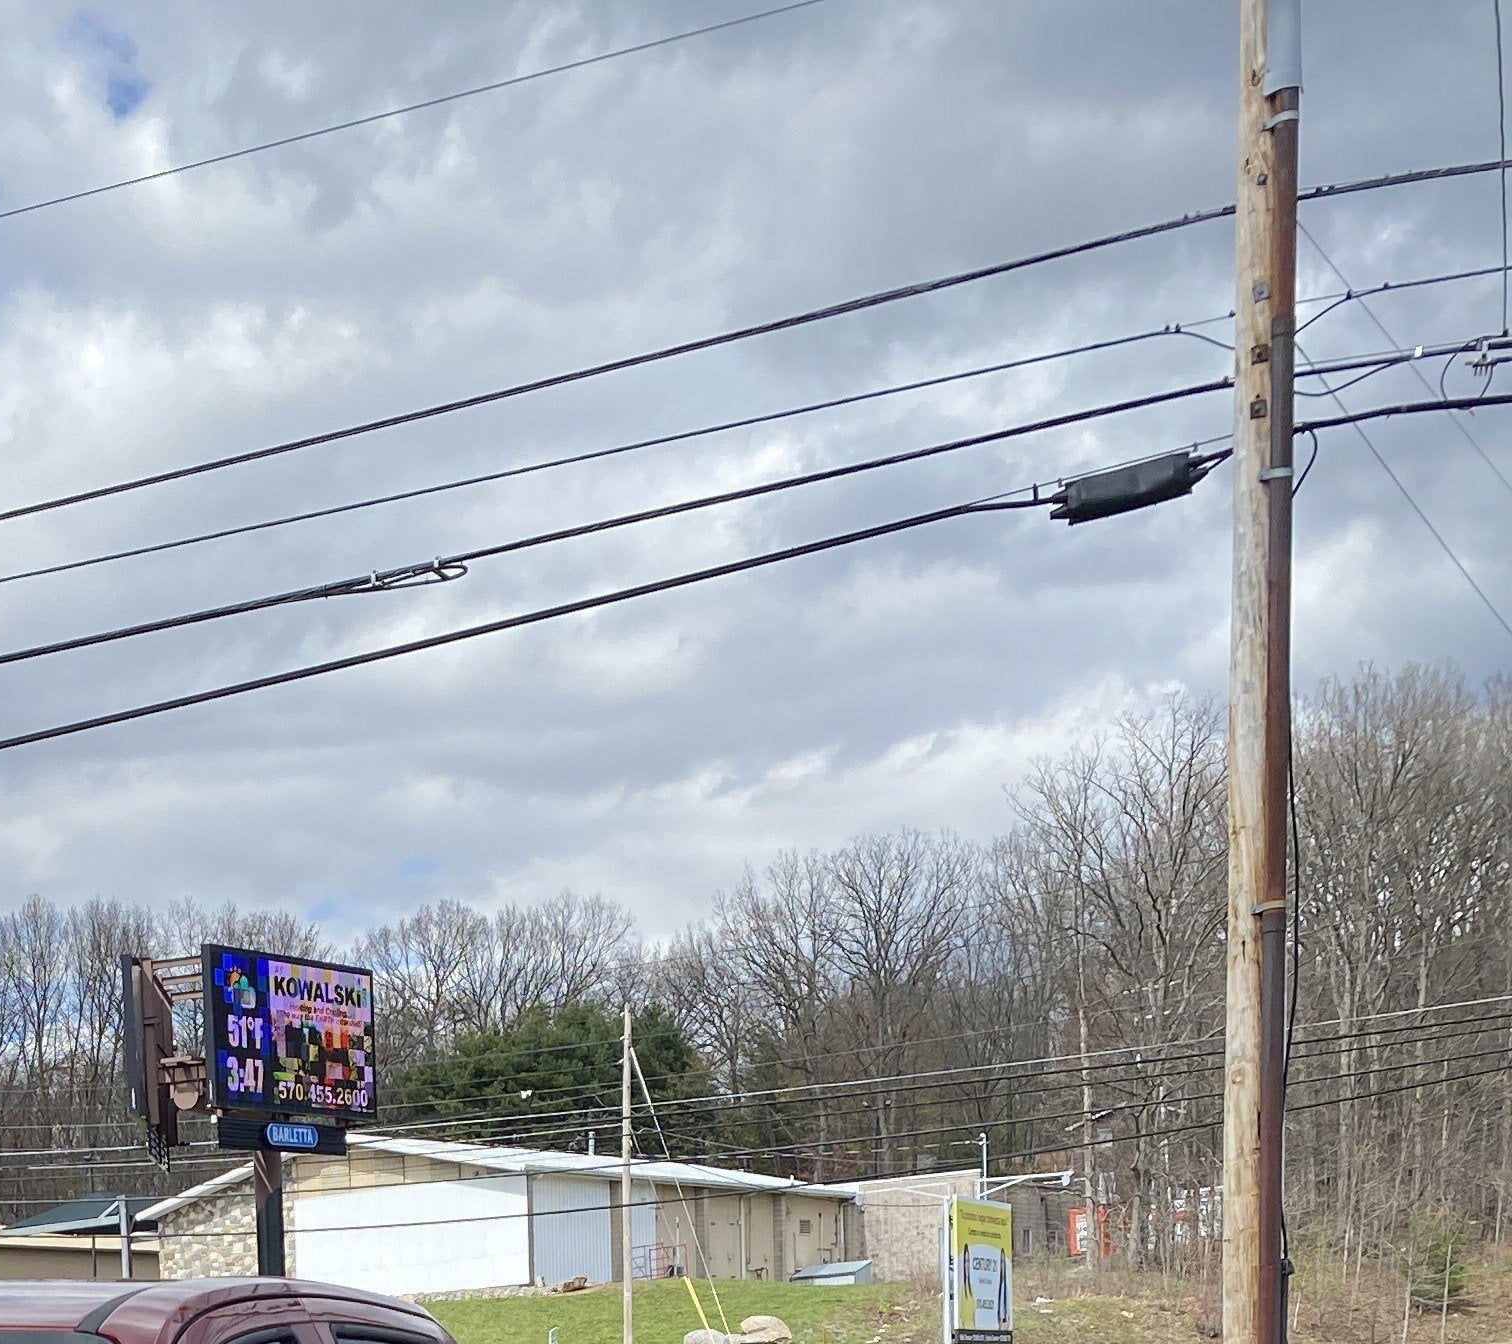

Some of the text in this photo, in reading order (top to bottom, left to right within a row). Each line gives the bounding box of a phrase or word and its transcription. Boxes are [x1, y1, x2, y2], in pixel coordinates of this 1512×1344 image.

[273, 976, 361, 1008] KOWALSKI
[226, 1056, 264, 1094] 3:47
[278, 1081, 368, 1107] 570.455.2600
[273, 1127, 313, 1144] BARLETTA
